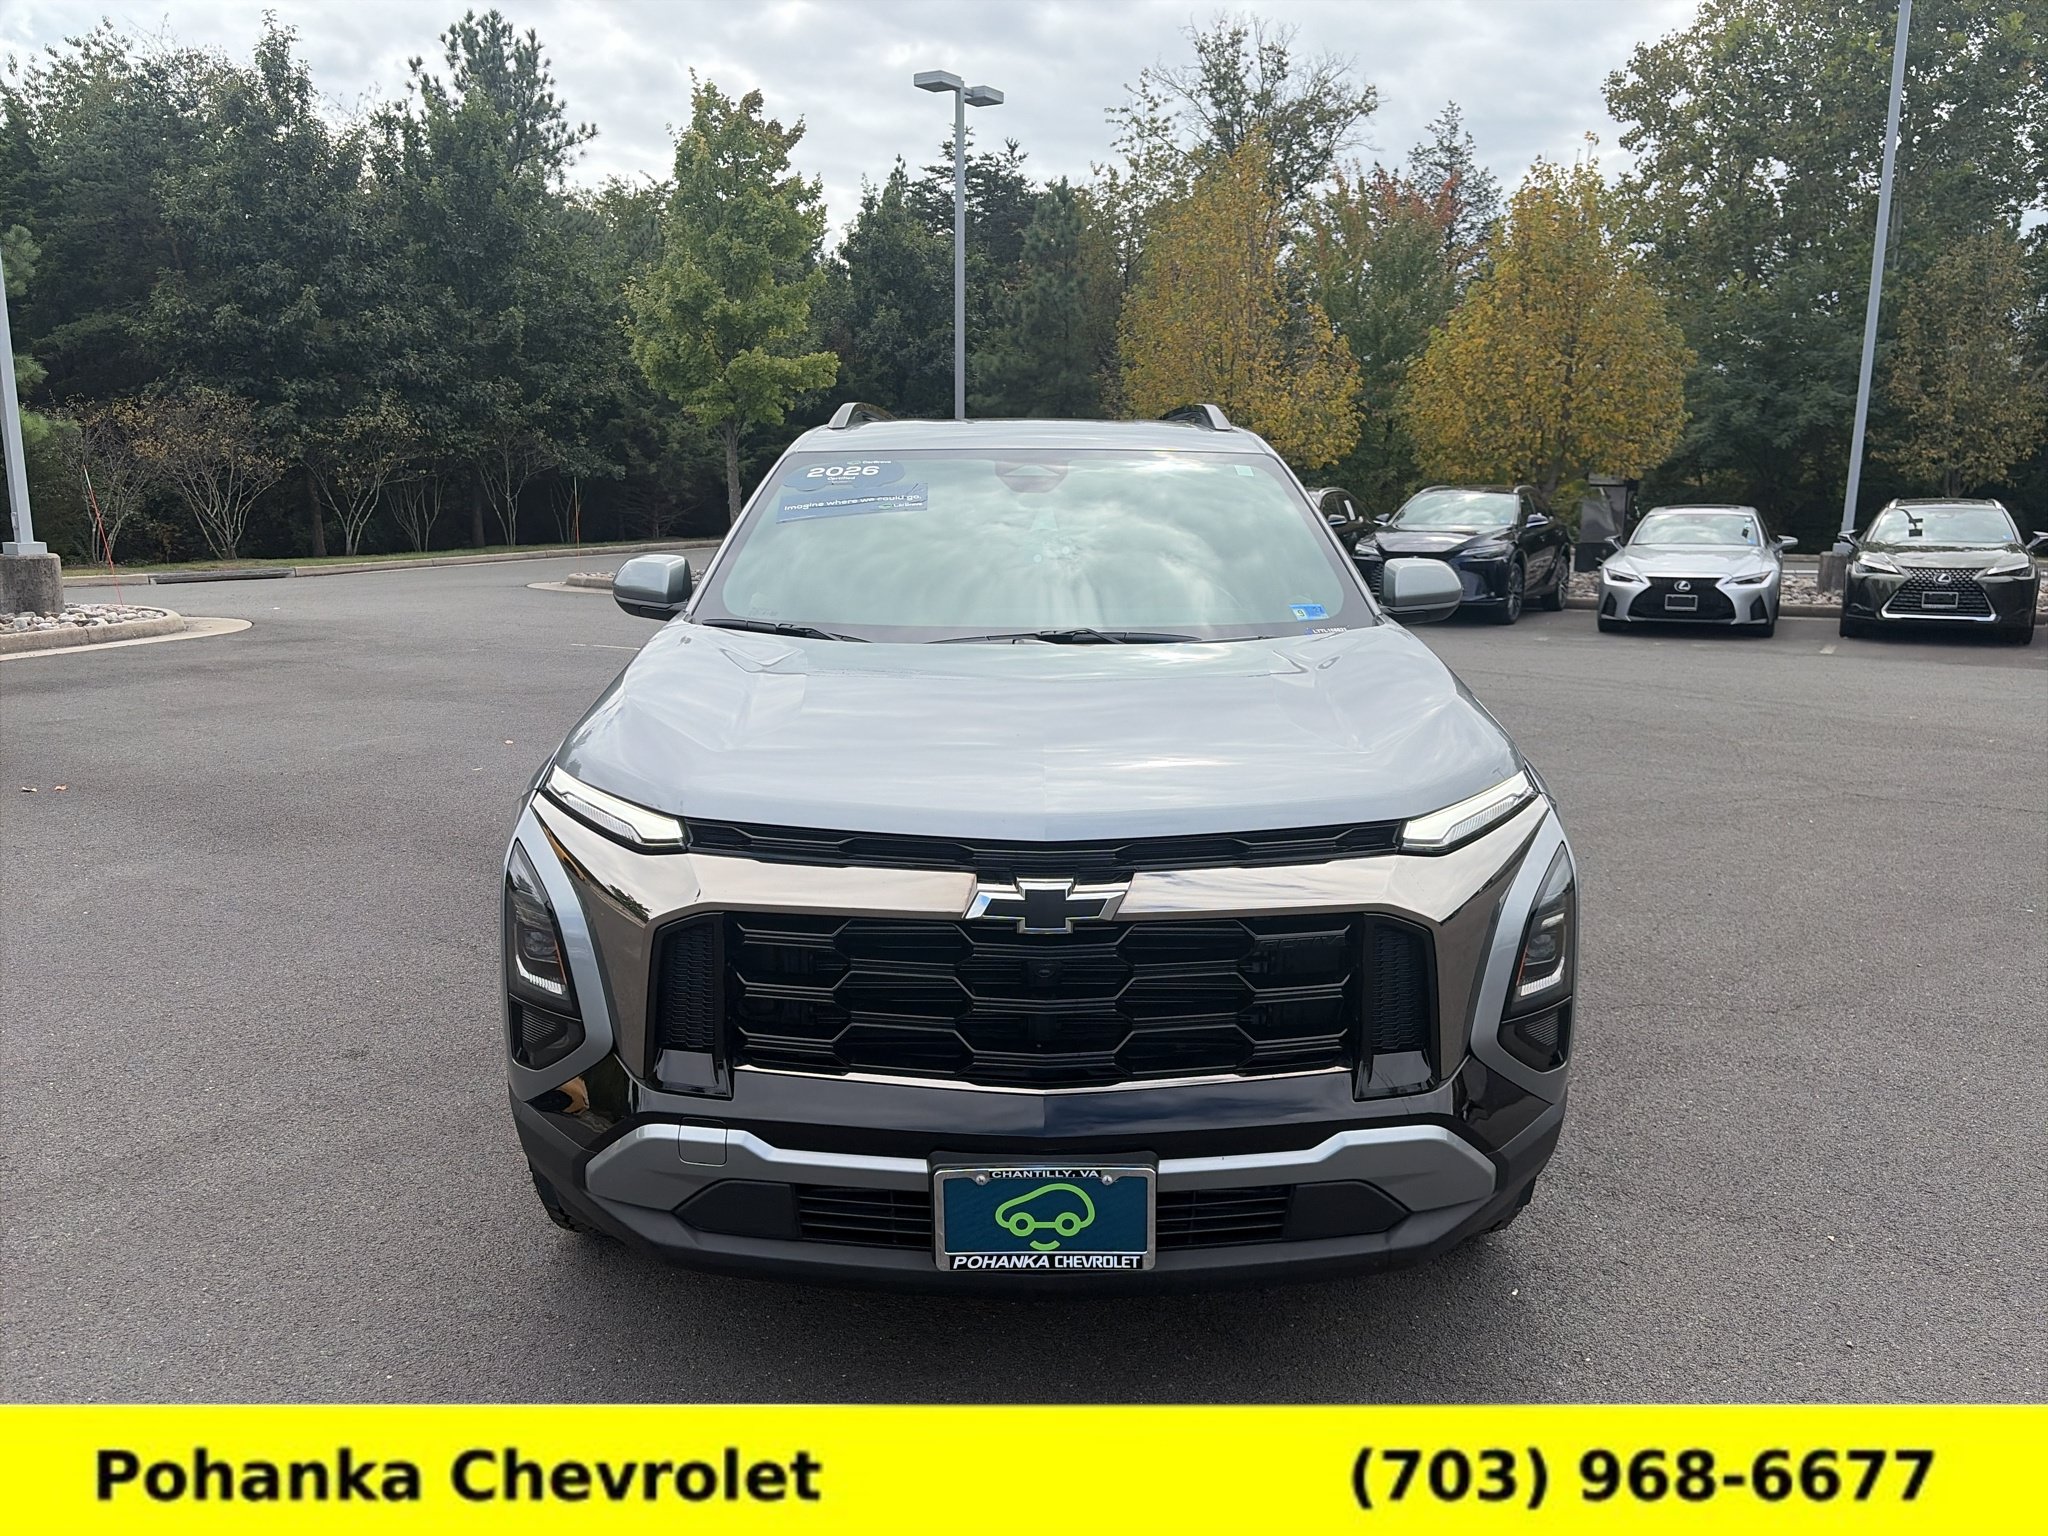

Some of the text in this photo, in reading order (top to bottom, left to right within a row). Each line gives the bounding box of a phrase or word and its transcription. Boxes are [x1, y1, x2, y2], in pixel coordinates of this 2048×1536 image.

[807, 466, 880, 478] 2026
[784, 502, 824, 511] Imagine
[826, 498, 858, 506] where
[1297, 609, 1305, 617] 9
[953, 1255, 1140, 1269] POHANKA CHEVROLET
